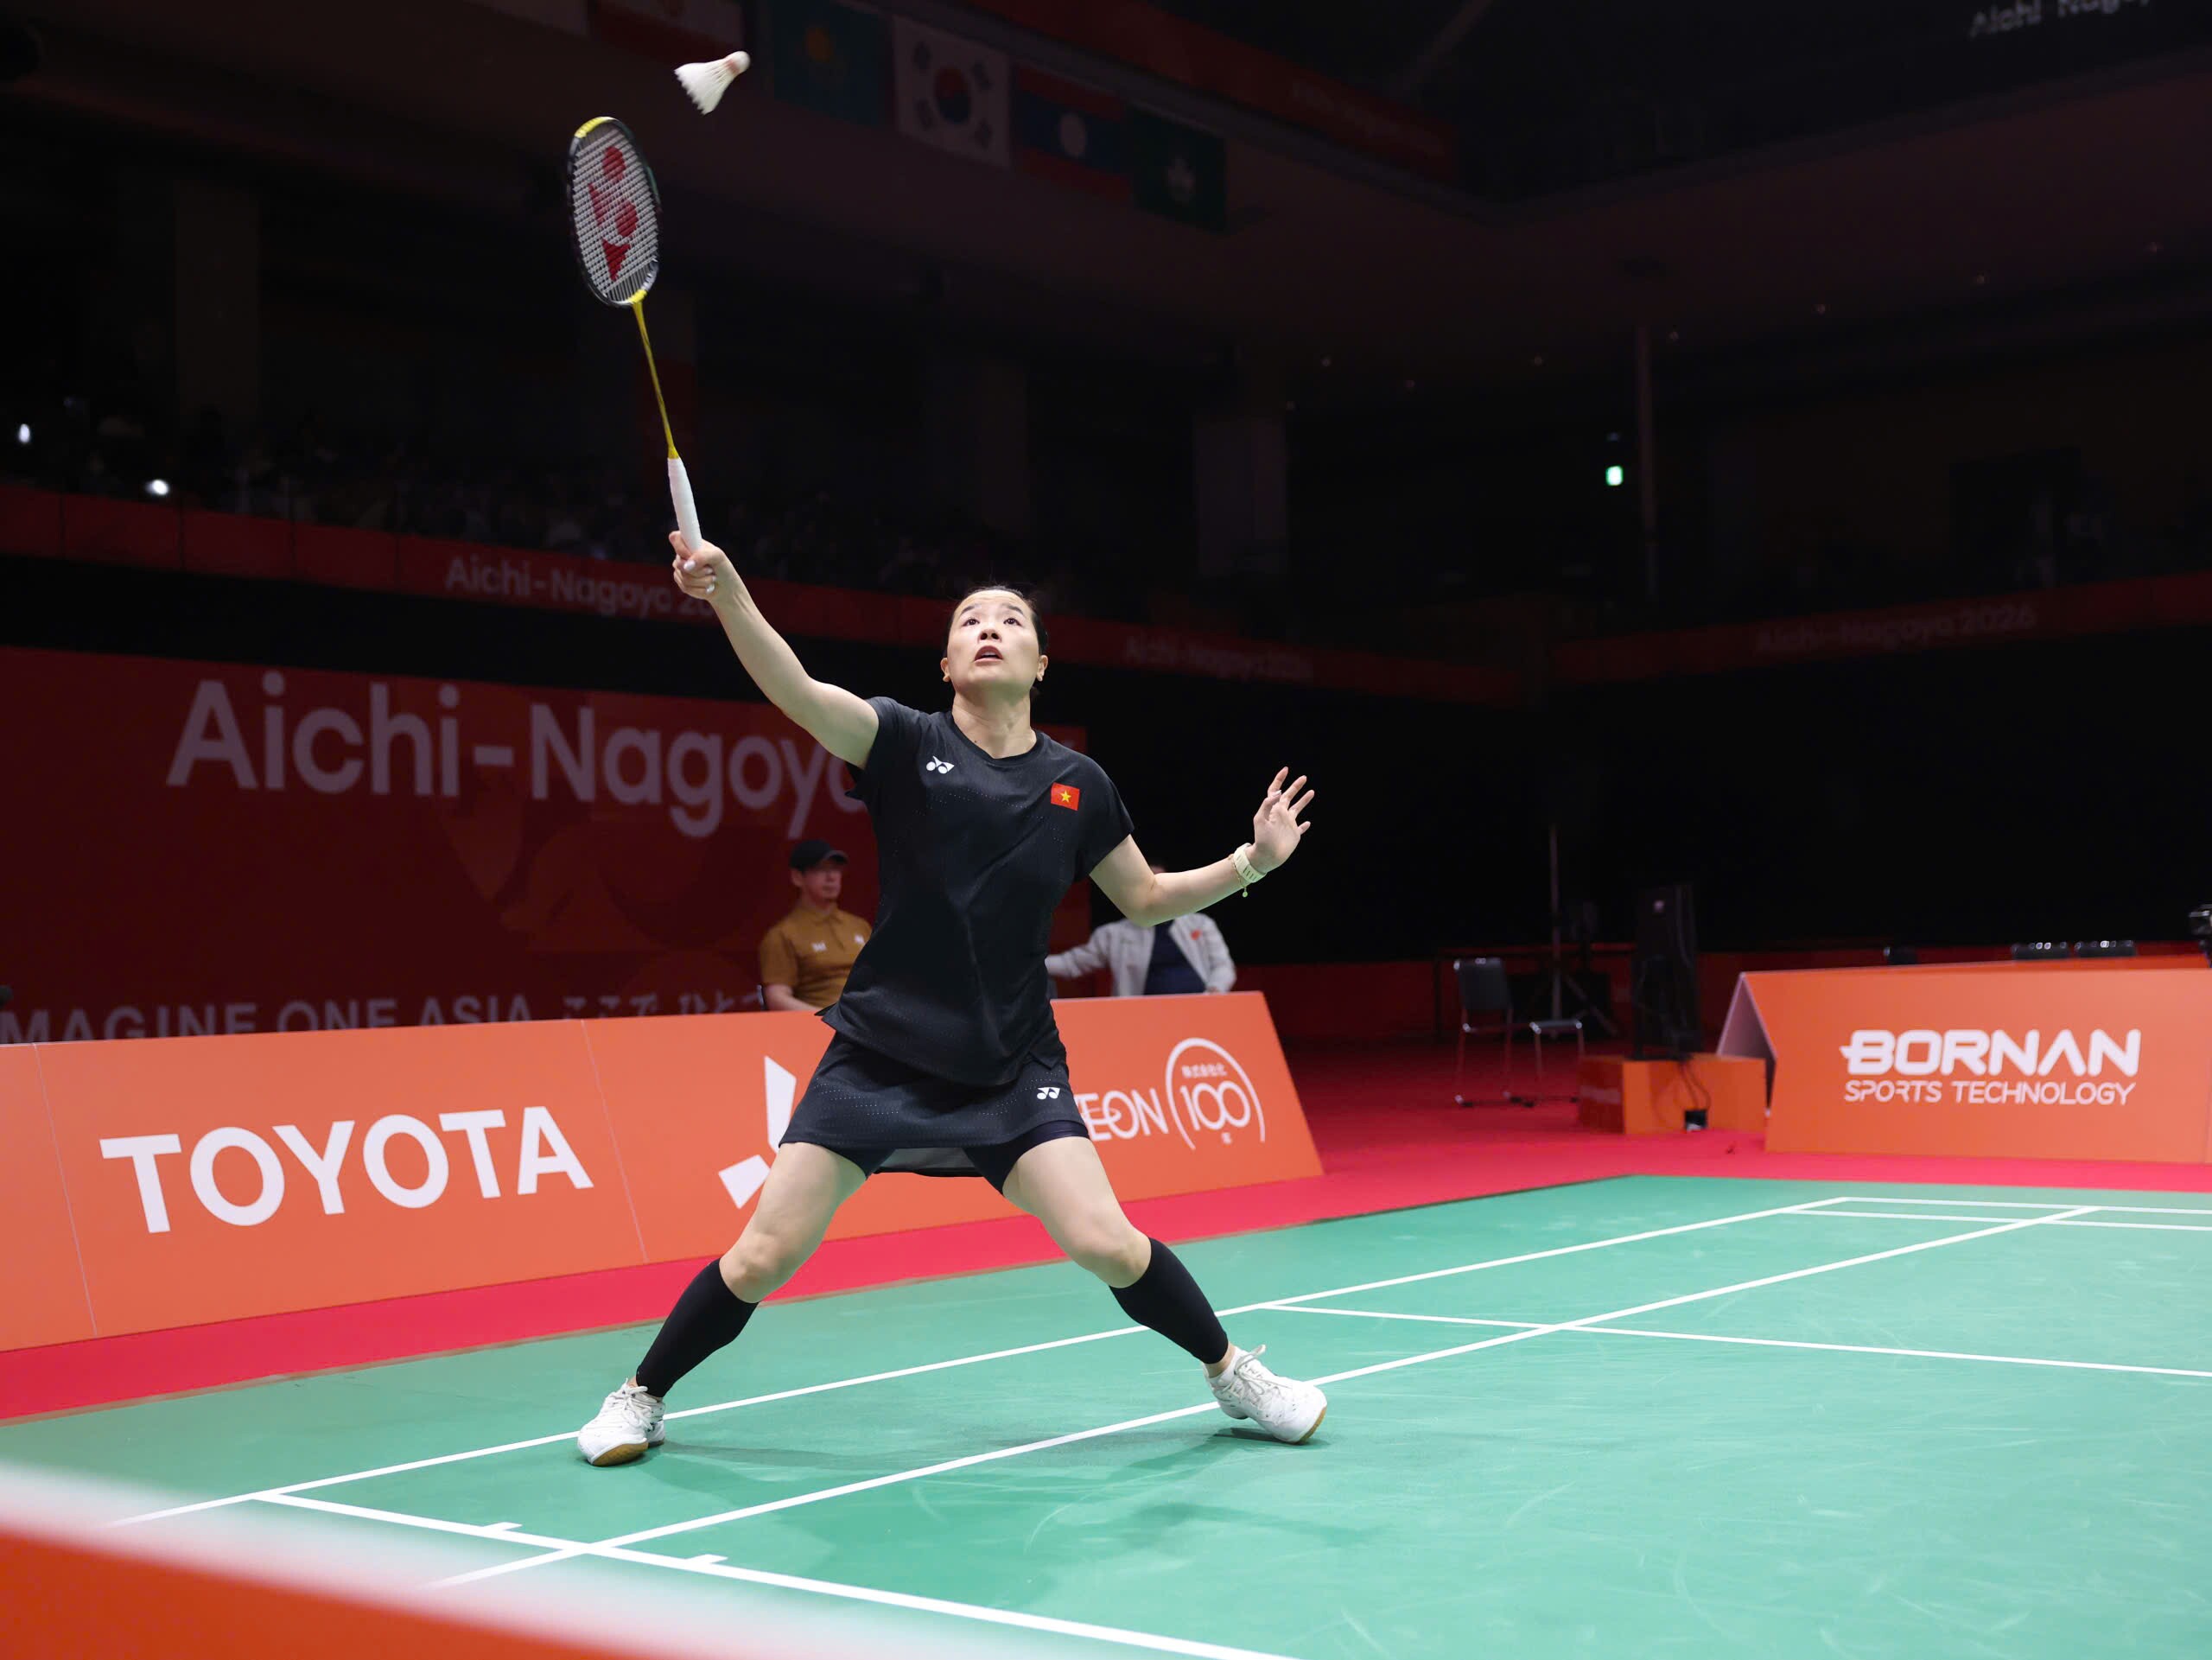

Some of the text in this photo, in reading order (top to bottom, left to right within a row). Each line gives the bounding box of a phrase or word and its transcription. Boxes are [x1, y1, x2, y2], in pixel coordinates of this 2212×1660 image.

[443, 553, 672, 620] Aichi-Nagoya
[276, 997, 398, 1032] ONE
[419, 993, 531, 1027] ASIA
[1839, 1028, 2141, 1077] BORNAN
[1179, 1080, 1251, 1130] 100
[1844, 1079, 2137, 1106] SPORTS TECHNOLOGY
[99, 1105, 594, 1234] TOYOTA
